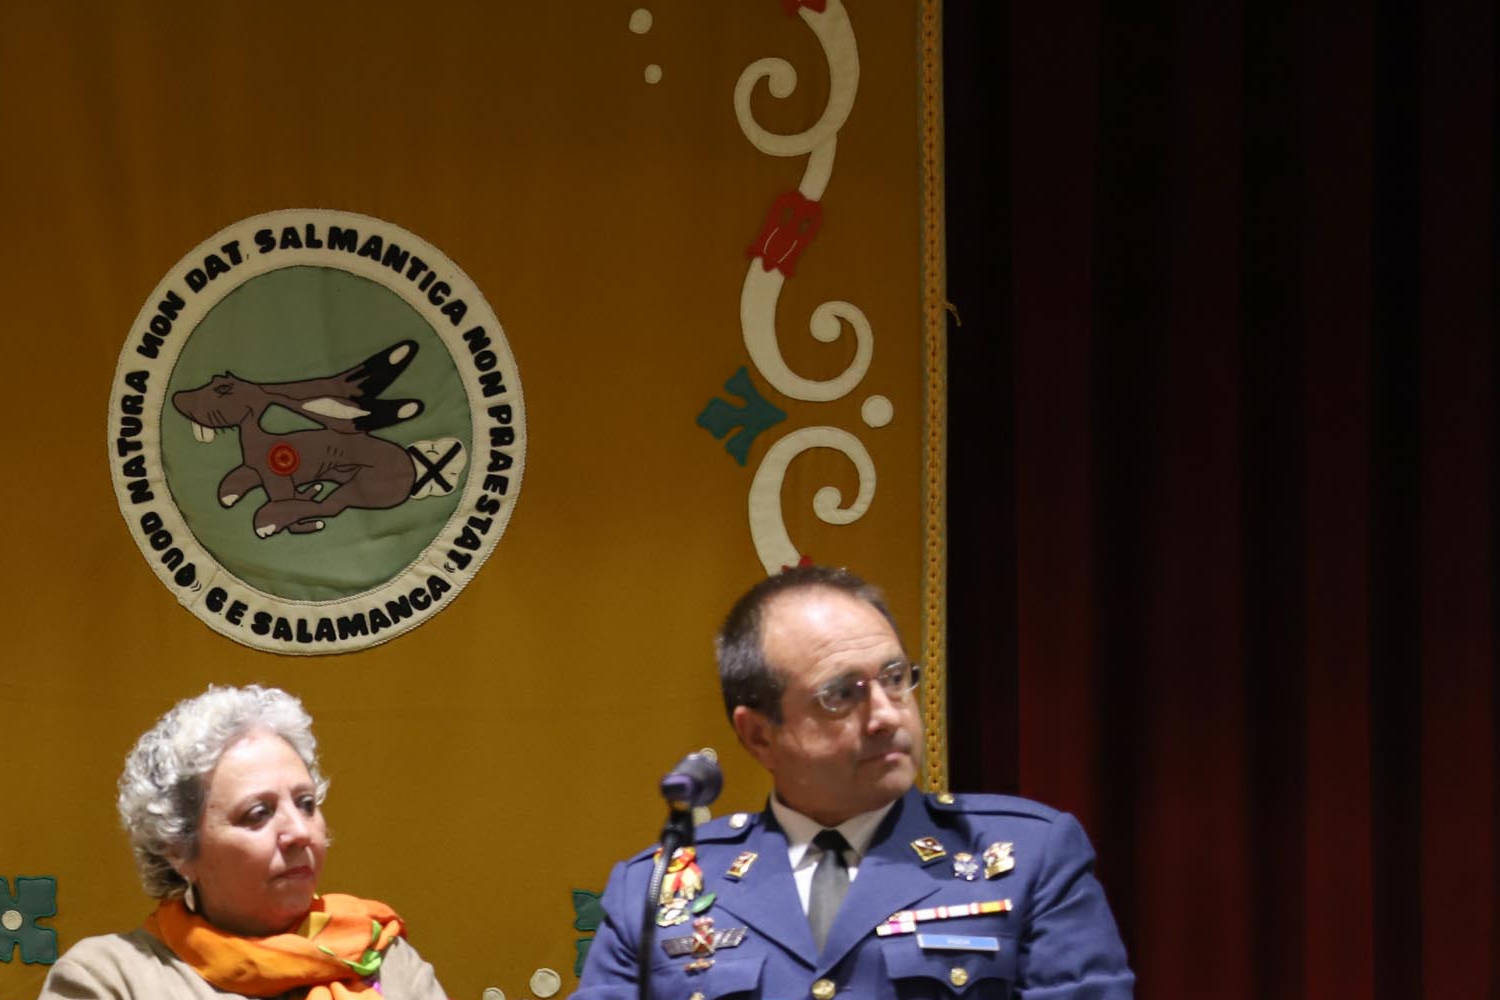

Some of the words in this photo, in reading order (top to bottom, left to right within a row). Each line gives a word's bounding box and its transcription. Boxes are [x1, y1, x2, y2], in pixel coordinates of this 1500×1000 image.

[116, 370, 150, 504] NATURA
[254, 223, 468, 327] SALMANTICA
[462, 325, 507, 398] NON
[251, 574, 451, 643] SALAMANCA
